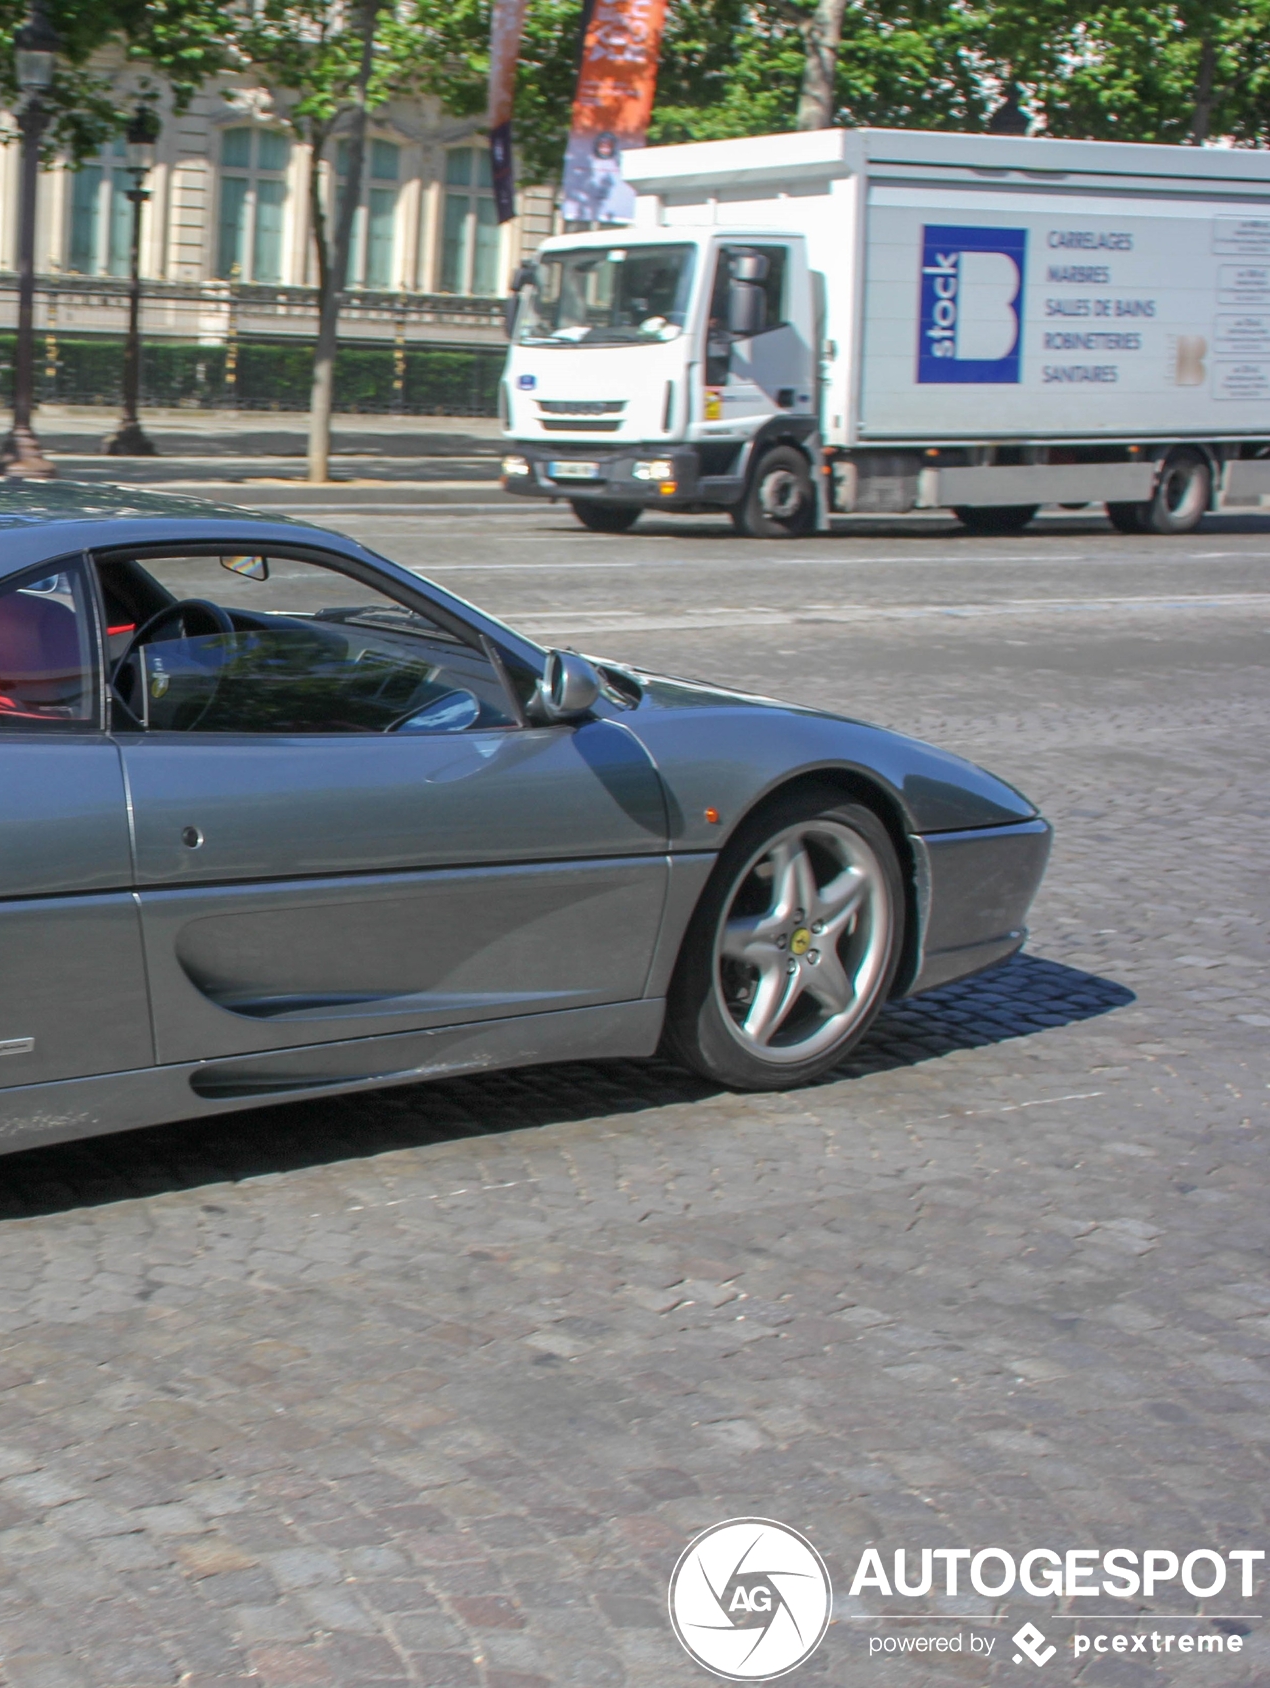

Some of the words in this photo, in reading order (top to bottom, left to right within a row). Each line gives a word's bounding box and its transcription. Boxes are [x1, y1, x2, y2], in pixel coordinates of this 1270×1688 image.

[1047, 231, 1134, 251] CARRELAGES
[1046, 265, 1110, 284] MARBRES
[921, 251, 959, 358] stock
[954, 250, 1021, 361] B
[1044, 299, 1090, 317] SALLES
[1094, 300, 1111, 317] DE
[1115, 300, 1156, 317] BAINS
[1043, 332, 1142, 350] ROBINETTERIES
